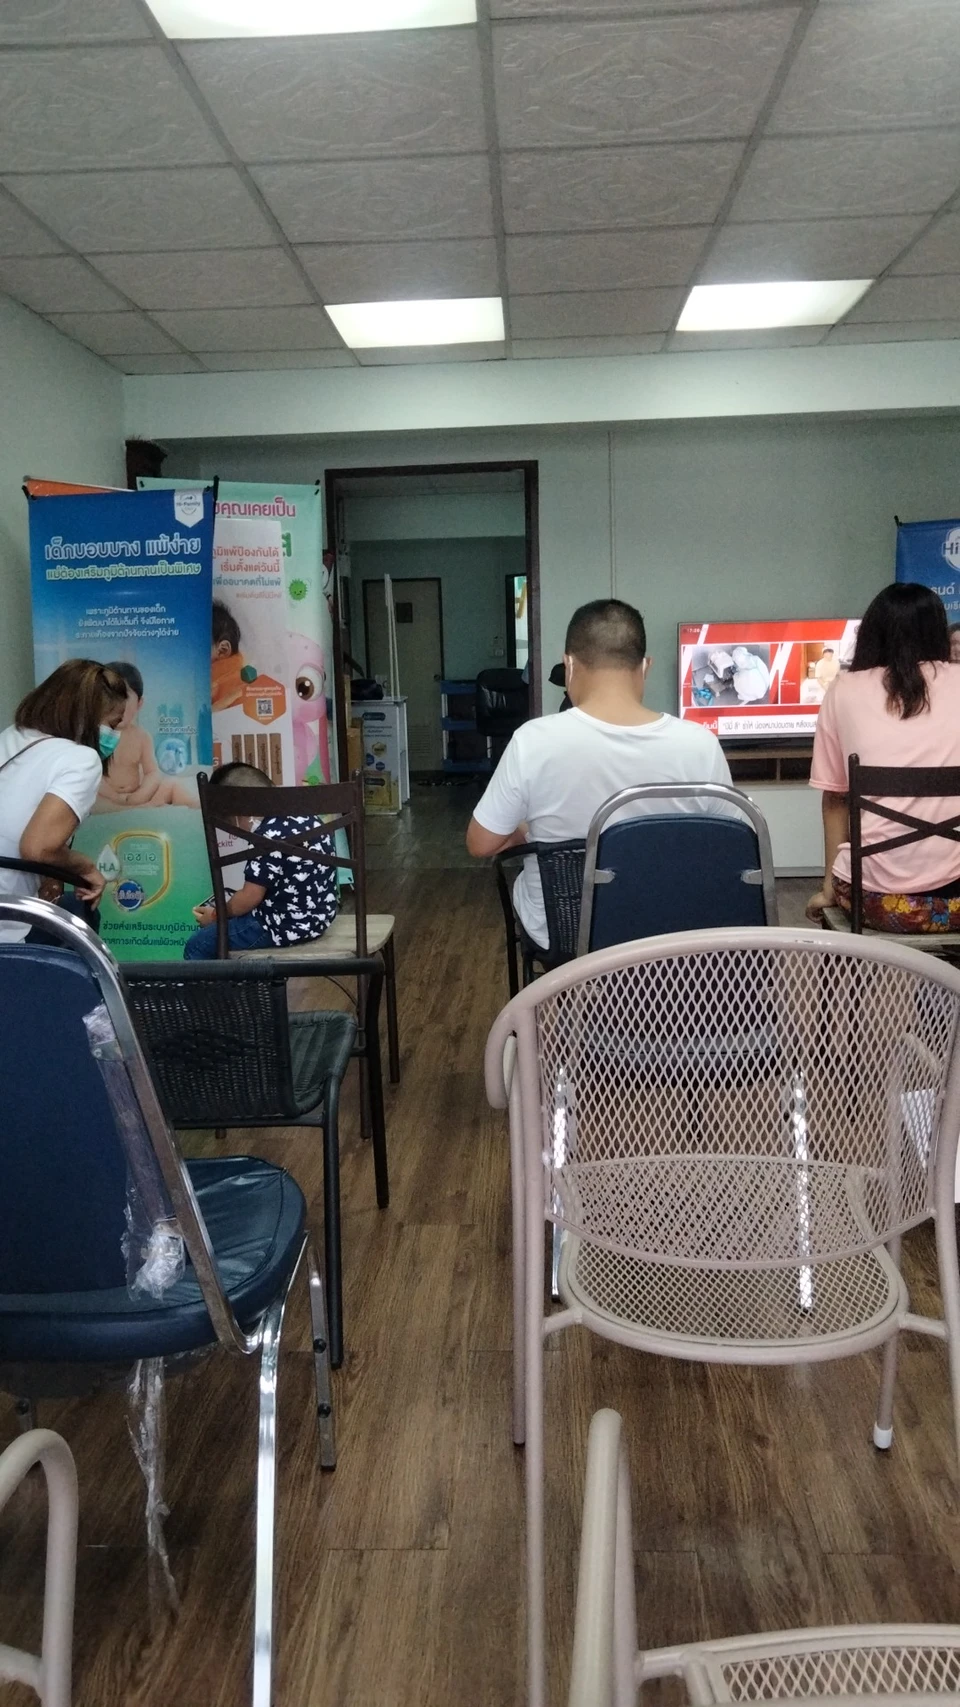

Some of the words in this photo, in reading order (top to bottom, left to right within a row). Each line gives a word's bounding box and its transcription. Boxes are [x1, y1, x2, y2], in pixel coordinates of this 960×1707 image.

[45, 536, 141, 560] เด็กบอบบาง
[145, 532, 202, 556] แพ้ง่าย
[46, 560, 202, 581] แม่ต้องเสริมภูมิต้านทานเป็นพิเศษ
[221, 559, 280, 573] เริ่มตั้งแต่วันนี้
